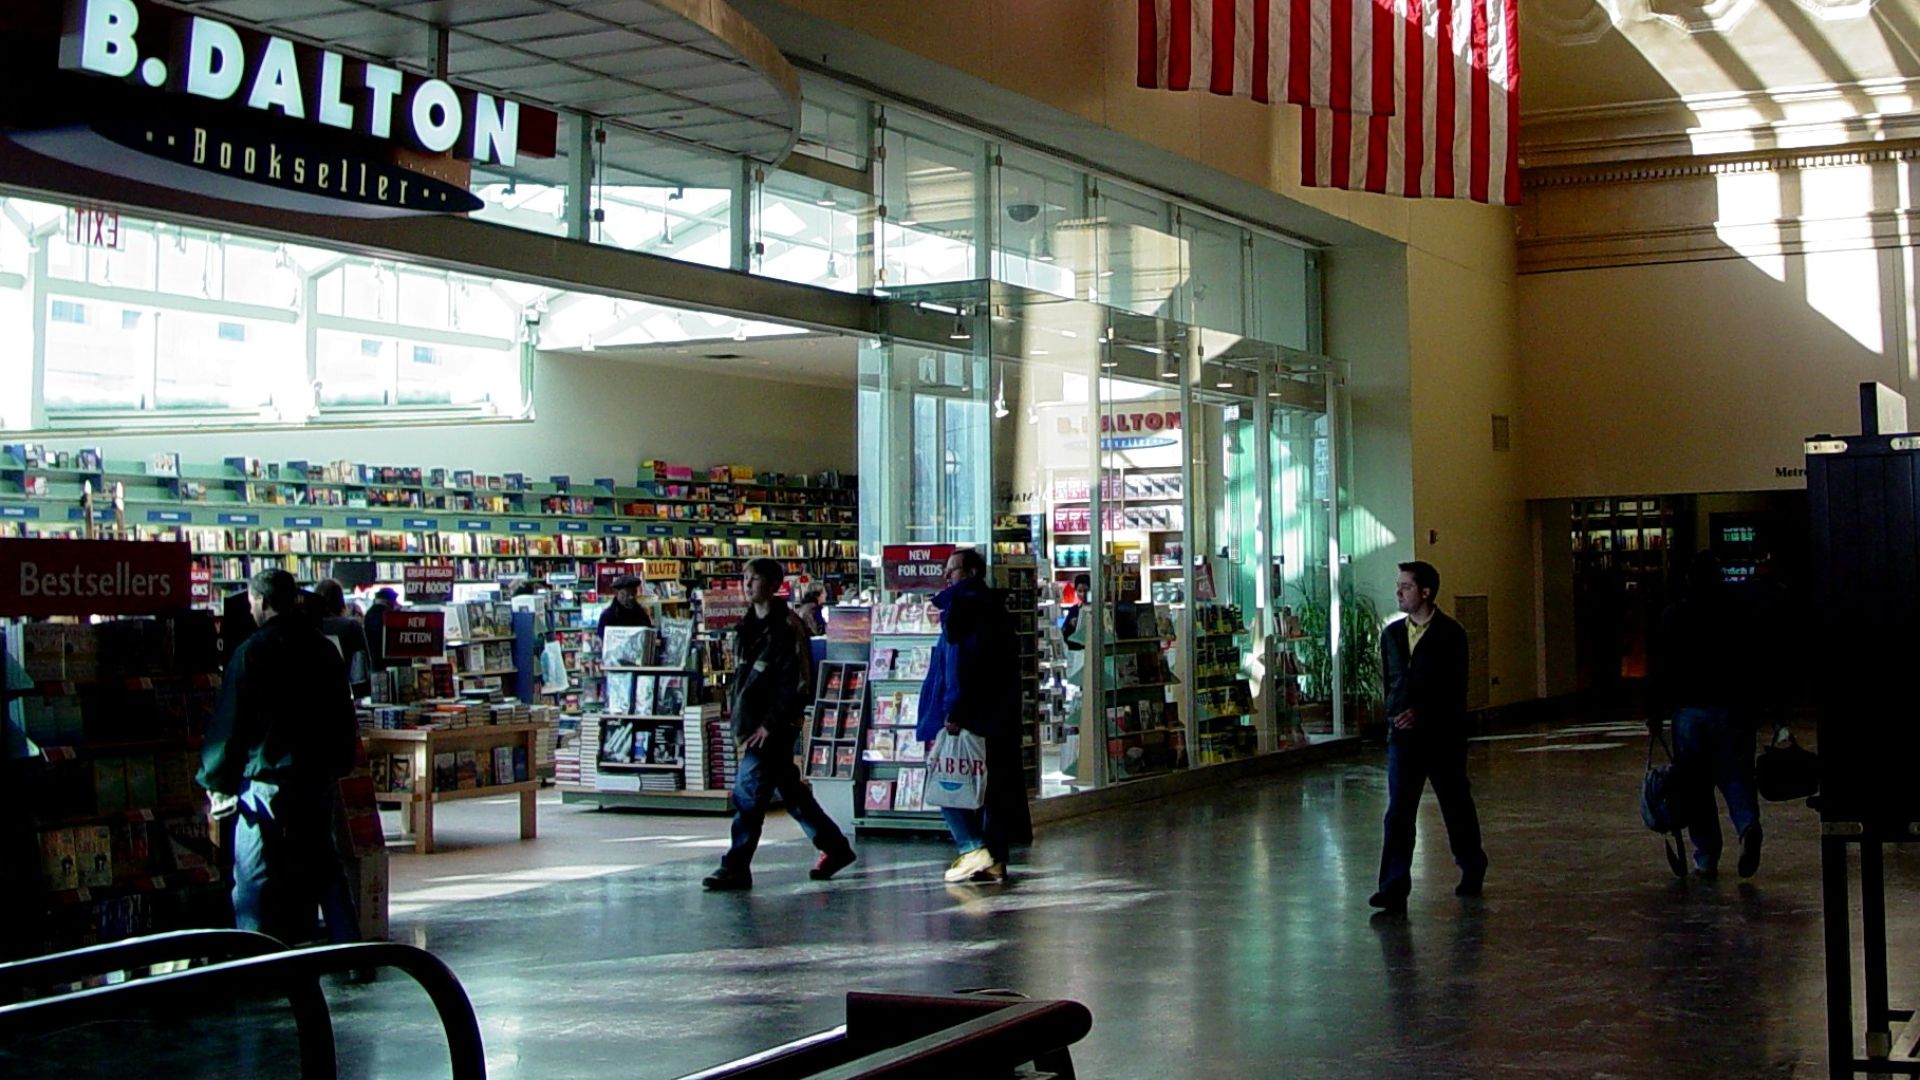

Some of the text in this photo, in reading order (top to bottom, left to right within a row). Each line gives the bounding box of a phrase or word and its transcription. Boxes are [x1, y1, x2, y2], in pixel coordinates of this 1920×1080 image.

[193, 127, 408, 204] Bookseller
[909, 549, 931, 561] NEW
[648, 562, 677, 576] KLUTZ
[898, 564, 943, 576] FOR KIDS
[20, 562, 171, 596] Bestsellers
[407, 581, 451, 594] GIFT BOOKS
[408, 616, 426, 628] NEW
[399, 631, 432, 644] FICTION
